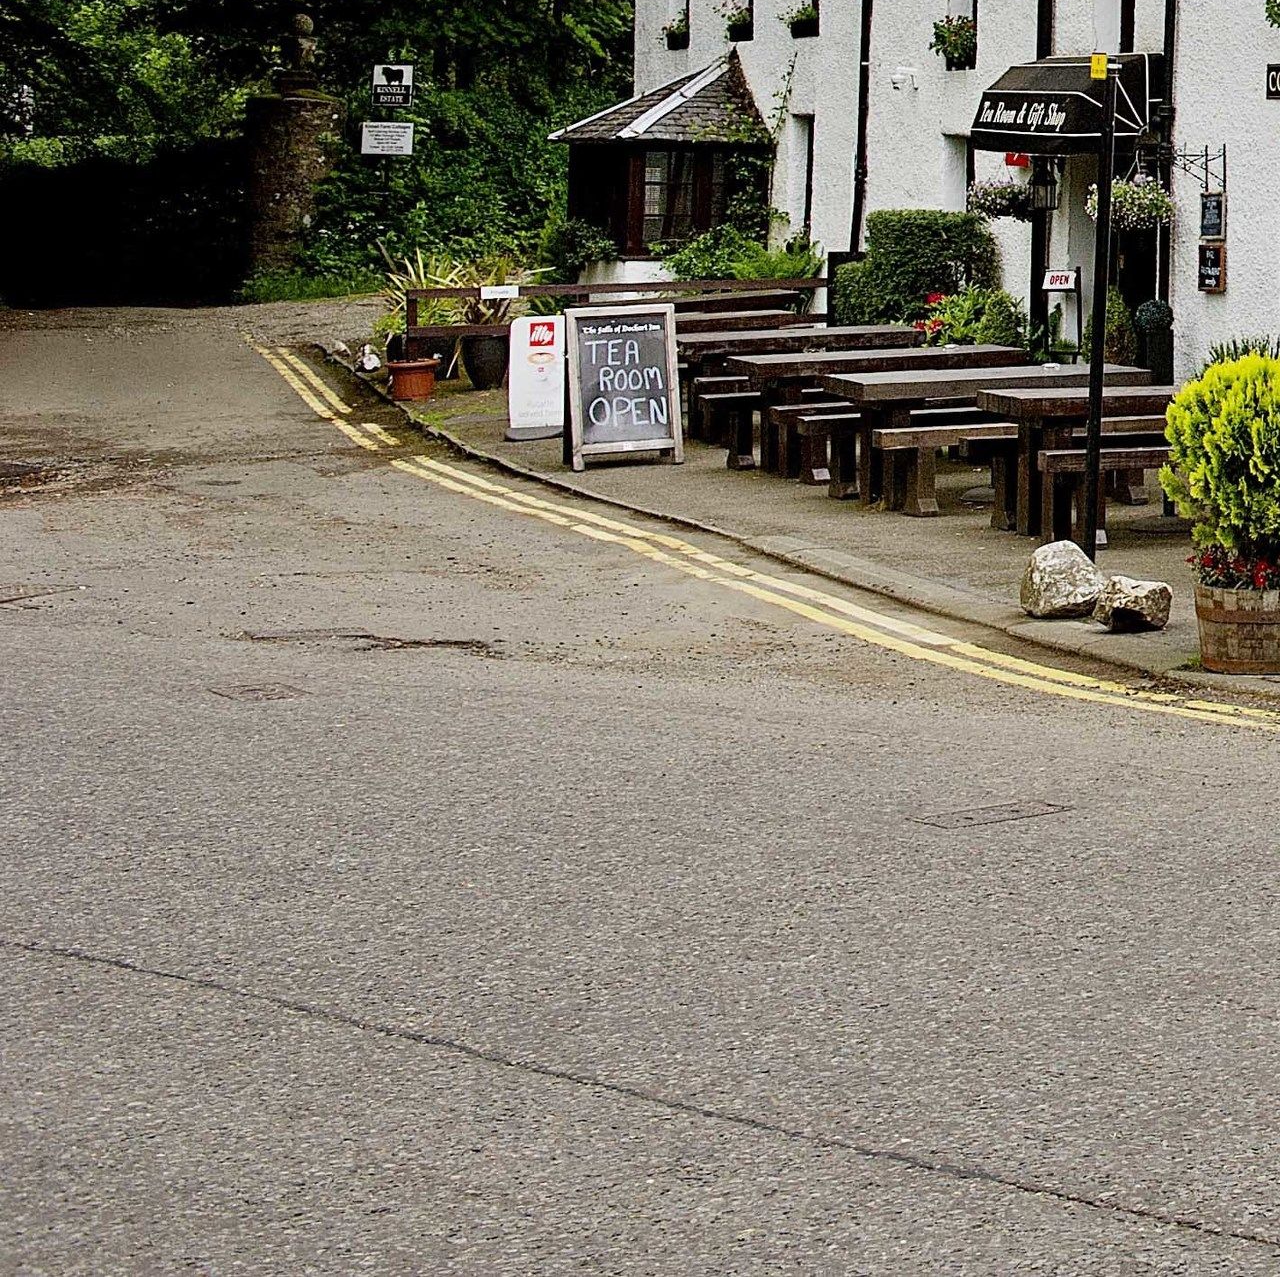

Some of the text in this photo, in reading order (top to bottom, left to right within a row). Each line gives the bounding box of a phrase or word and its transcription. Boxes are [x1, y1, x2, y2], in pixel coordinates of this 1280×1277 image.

[376, 86, 406, 94] KINNELL
[380, 95, 404, 103] ESTATE
[979, 101, 1066, 132] Tea Room & Gift Shop
[1050, 274, 1070, 285] OPEN
[530, 324, 554, 345] illy
[584, 339, 640, 365] TEA
[600, 366, 663, 392] ROOM
[588, 396, 668, 427] OPEN
